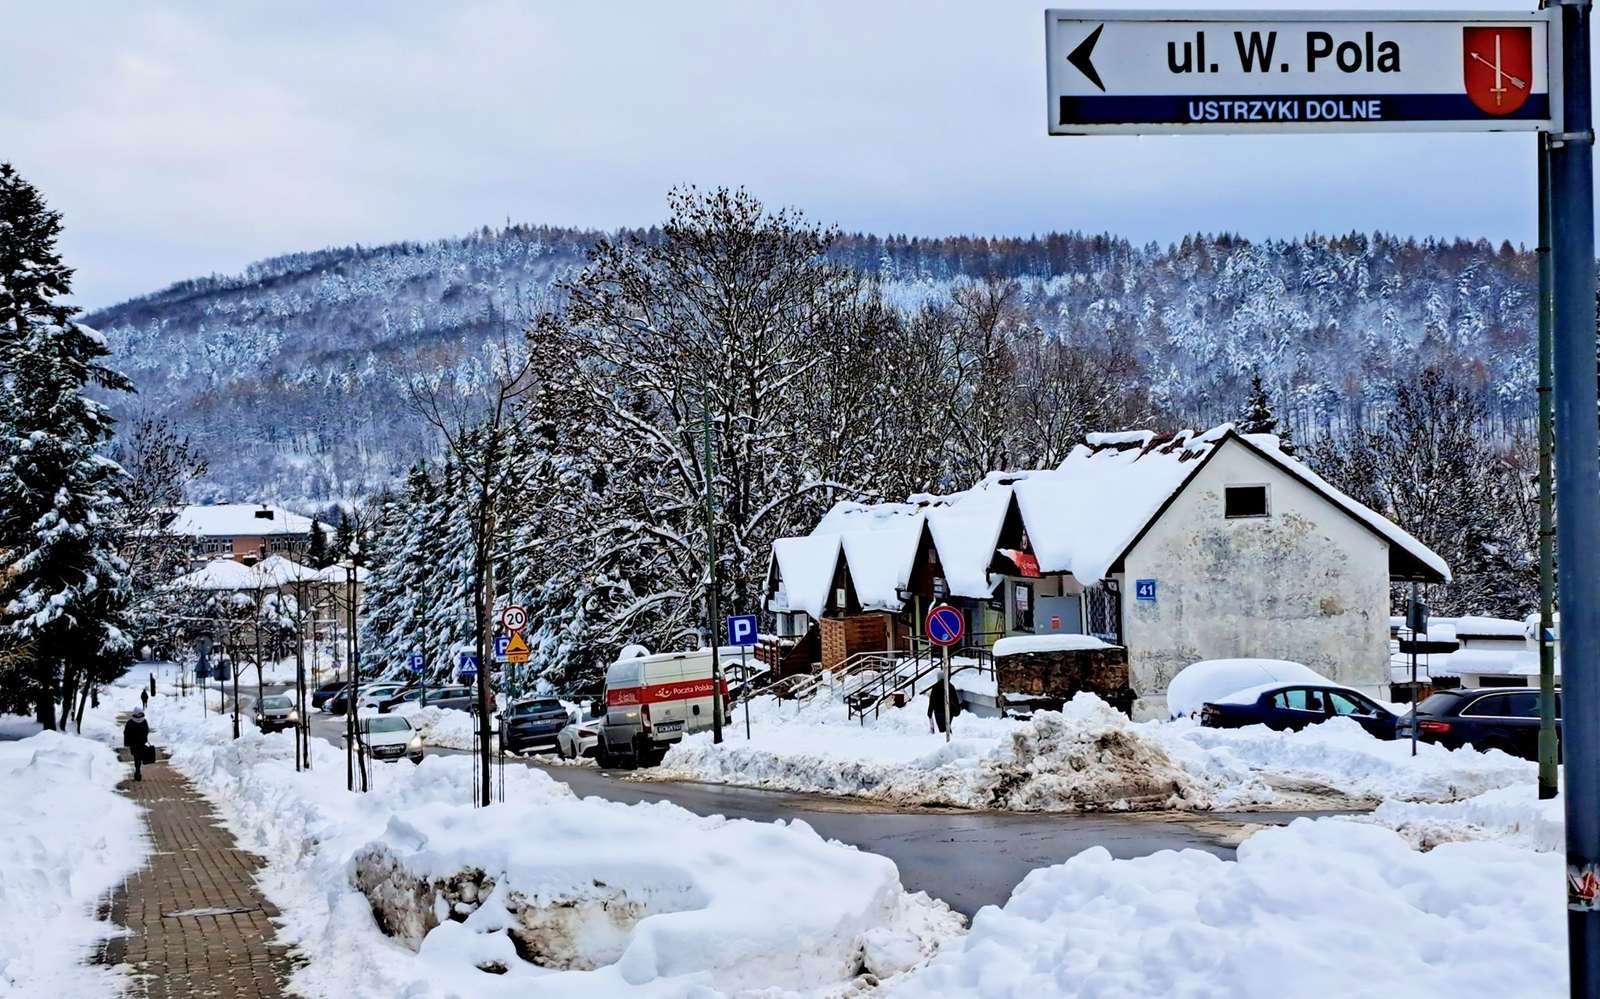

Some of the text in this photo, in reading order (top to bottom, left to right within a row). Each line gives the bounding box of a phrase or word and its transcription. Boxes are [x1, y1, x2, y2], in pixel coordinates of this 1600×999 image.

[1167, 30, 1402, 75] ul. W. Pola
[1188, 100, 1383, 121] USTRZYKI DOLNE
[1139, 584, 1153, 596] 41
[506, 612, 524, 626] 20
[734, 619, 751, 643] P
[414, 656, 424, 669] P
[672, 687, 694, 696] Poczta
